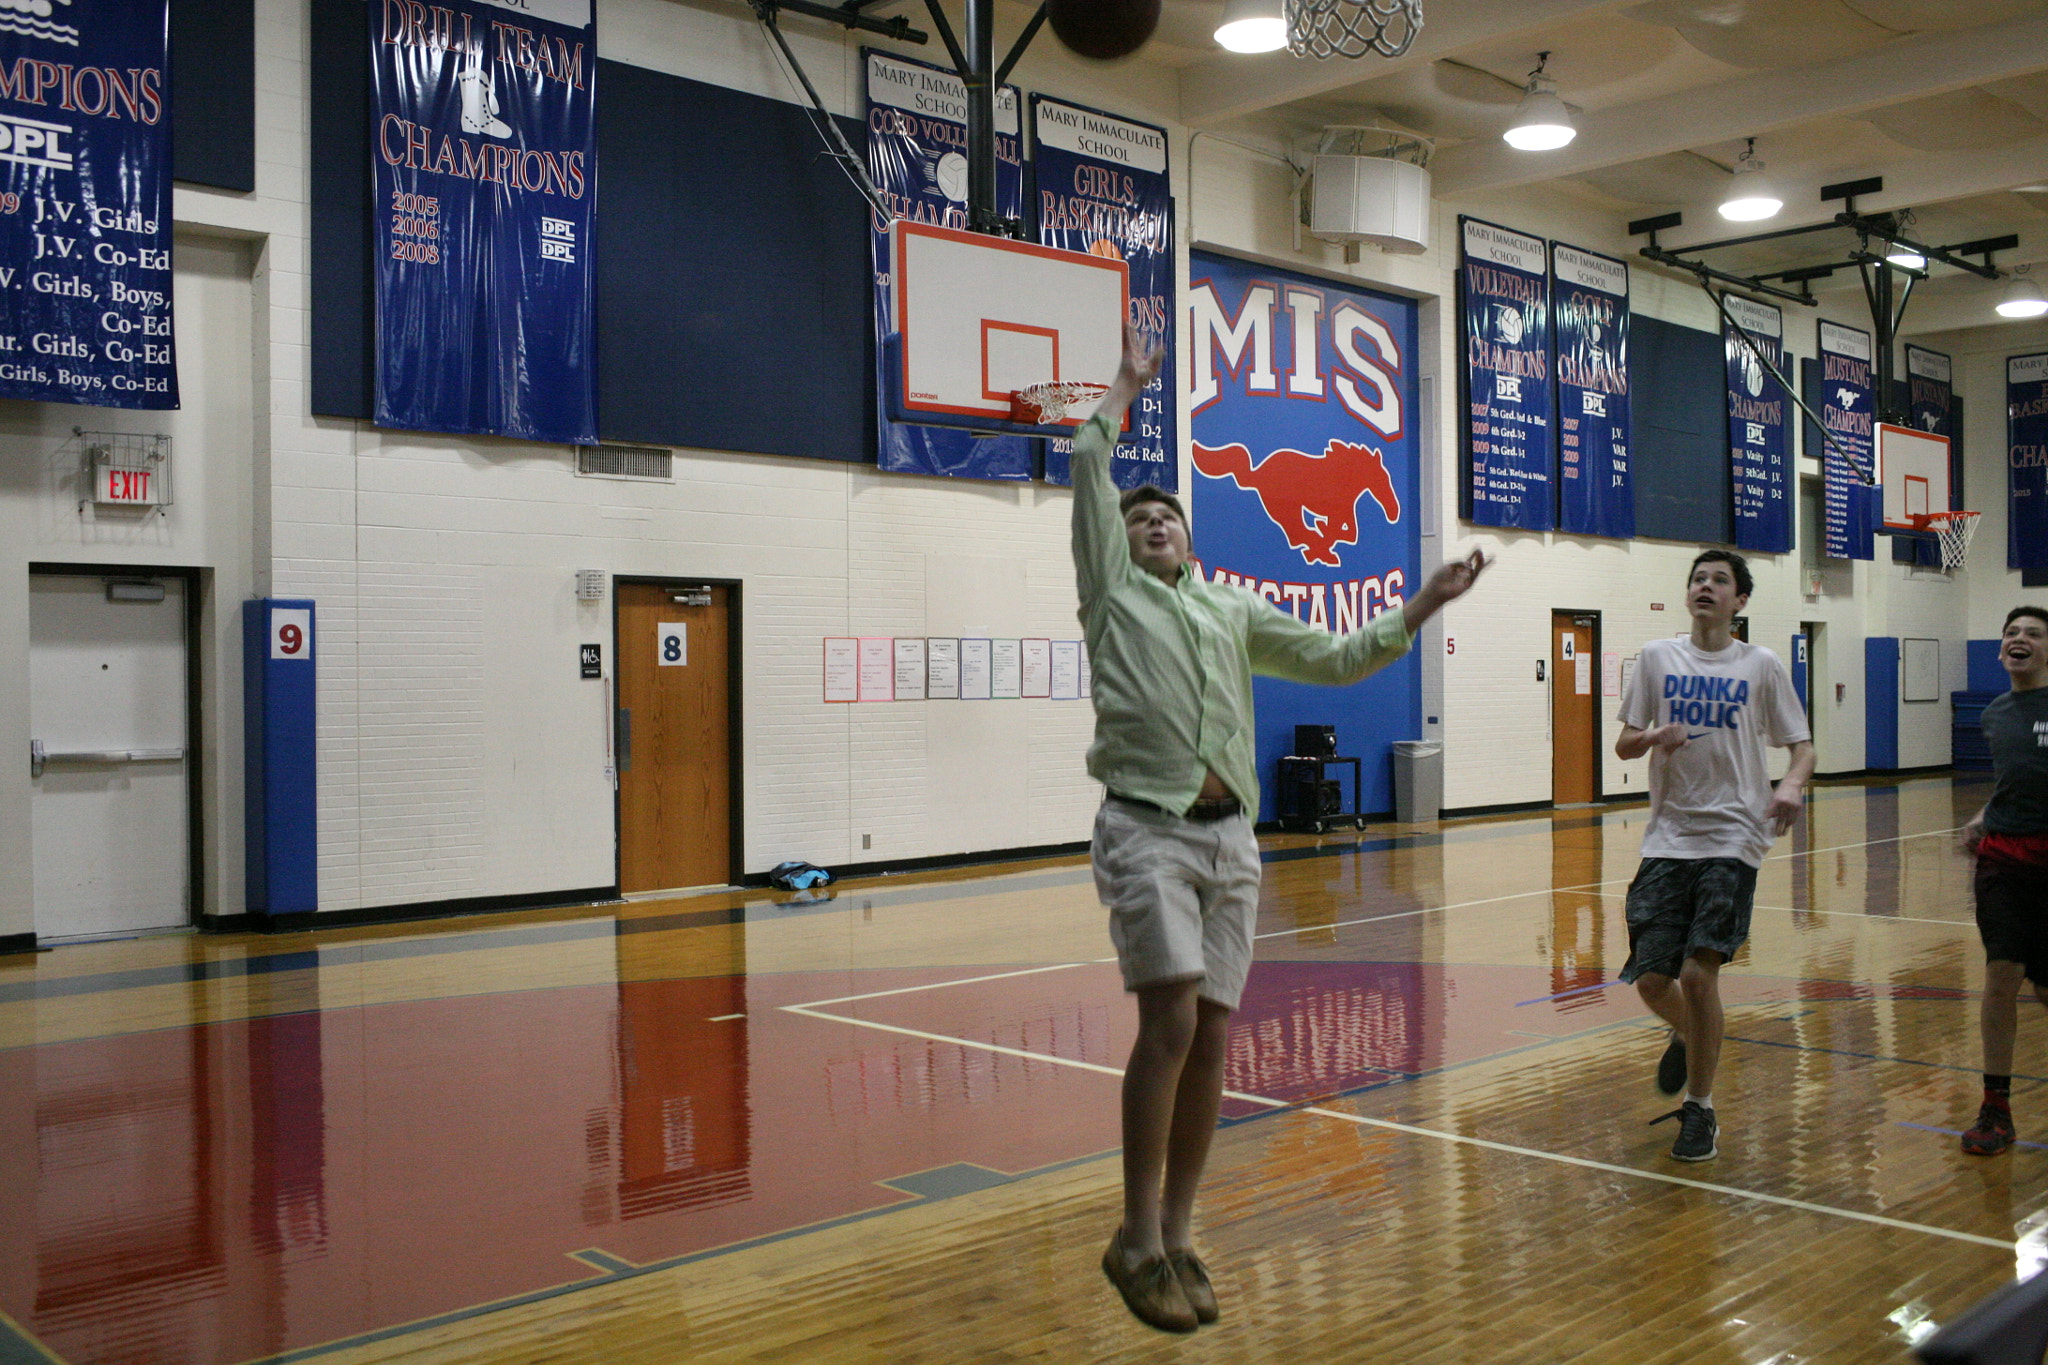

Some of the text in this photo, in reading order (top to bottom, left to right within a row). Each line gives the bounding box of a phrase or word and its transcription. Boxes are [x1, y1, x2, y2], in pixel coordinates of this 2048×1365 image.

[381, 0, 584, 91] DRILL TEAM
[874, 61, 916, 90] MARY
[915, 94, 967, 119] SCHOO
[1041, 105, 1162, 150] MARY IMMACULATE
[380, 113, 585, 200] CHAMPIONS
[1078, 136, 1130, 162] SCHOOL
[1074, 164, 1134, 203] GIRLS
[391, 191, 439, 216] 2005
[35, 198, 157, 235] J.V. Girls
[391, 214, 438, 239] 2006
[542, 219, 575, 238] DPL
[1042, 190, 1165, 253] BASKETBALL
[35, 233, 170, 271] J.V. Co-Ed
[391, 240, 439, 265] 2008
[542, 242, 575, 260] DPL
[1467, 225, 1542, 255] MARY IMMACULATE
[1490, 247, 1522, 266] SCHOOL
[1557, 251, 1624, 278] MARY IMMACULATE
[32, 271, 100, 303] Girls,
[111, 281, 171, 311] Boys,
[1467, 264, 1542, 309] VOLLEYBALL
[1577, 271, 1607, 289] SCHOOL
[1571, 291, 1613, 327] GOLF
[1743, 303, 1779, 321] IMMACULATE
[102, 312, 171, 337] Co-Ed
[1741, 317, 1764, 331] SCHOOL
[32, 332, 96, 363] Girls,
[105, 341, 171, 365] Co-Ed
[1190, 279, 1402, 441] MIS
[1469, 335, 1545, 380] CHAMPIONS
[0, 363, 168, 392] Girls, Boys, Co-Ed
[1559, 354, 1628, 396] CHAMPIONS
[1824, 354, 1870, 389] MUSTANG
[2013, 360, 2042, 370] MARY
[1142, 398, 1163, 414] D-1
[1500, 409, 1516, 420] Grd.
[1583, 395, 1606, 413] DPL
[1728, 390, 1781, 426] CHAMPIONS
[1142, 423, 1162, 439] D-2
[1500, 427, 1517, 438] Grd.
[1824, 404, 1871, 437] CHAMPIONS
[1612, 427, 1623, 440] J.V.
[1116, 444, 1139, 461] Grd.
[1142, 448, 1164, 462] Red
[1500, 446, 1517, 456] Grd.
[1612, 444, 1626, 456] VAR
[1771, 455, 1781, 465] D-1
[1612, 459, 1626, 472] VAR
[1771, 472, 1782, 483] J.V.
[110, 470, 150, 500] EXIT
[1612, 475, 1623, 487] J.V.
[1771, 489, 1782, 499] D-2
[279, 624, 302, 655] 9
[664, 636, 681, 661] 8
[1446, 638, 1455, 655] 5
[1565, 641, 1572, 657] 4
[1799, 646, 1805, 660] 2
[1664, 674, 1750, 706] DUNKA
[1669, 700, 1741, 730] HOLIC
